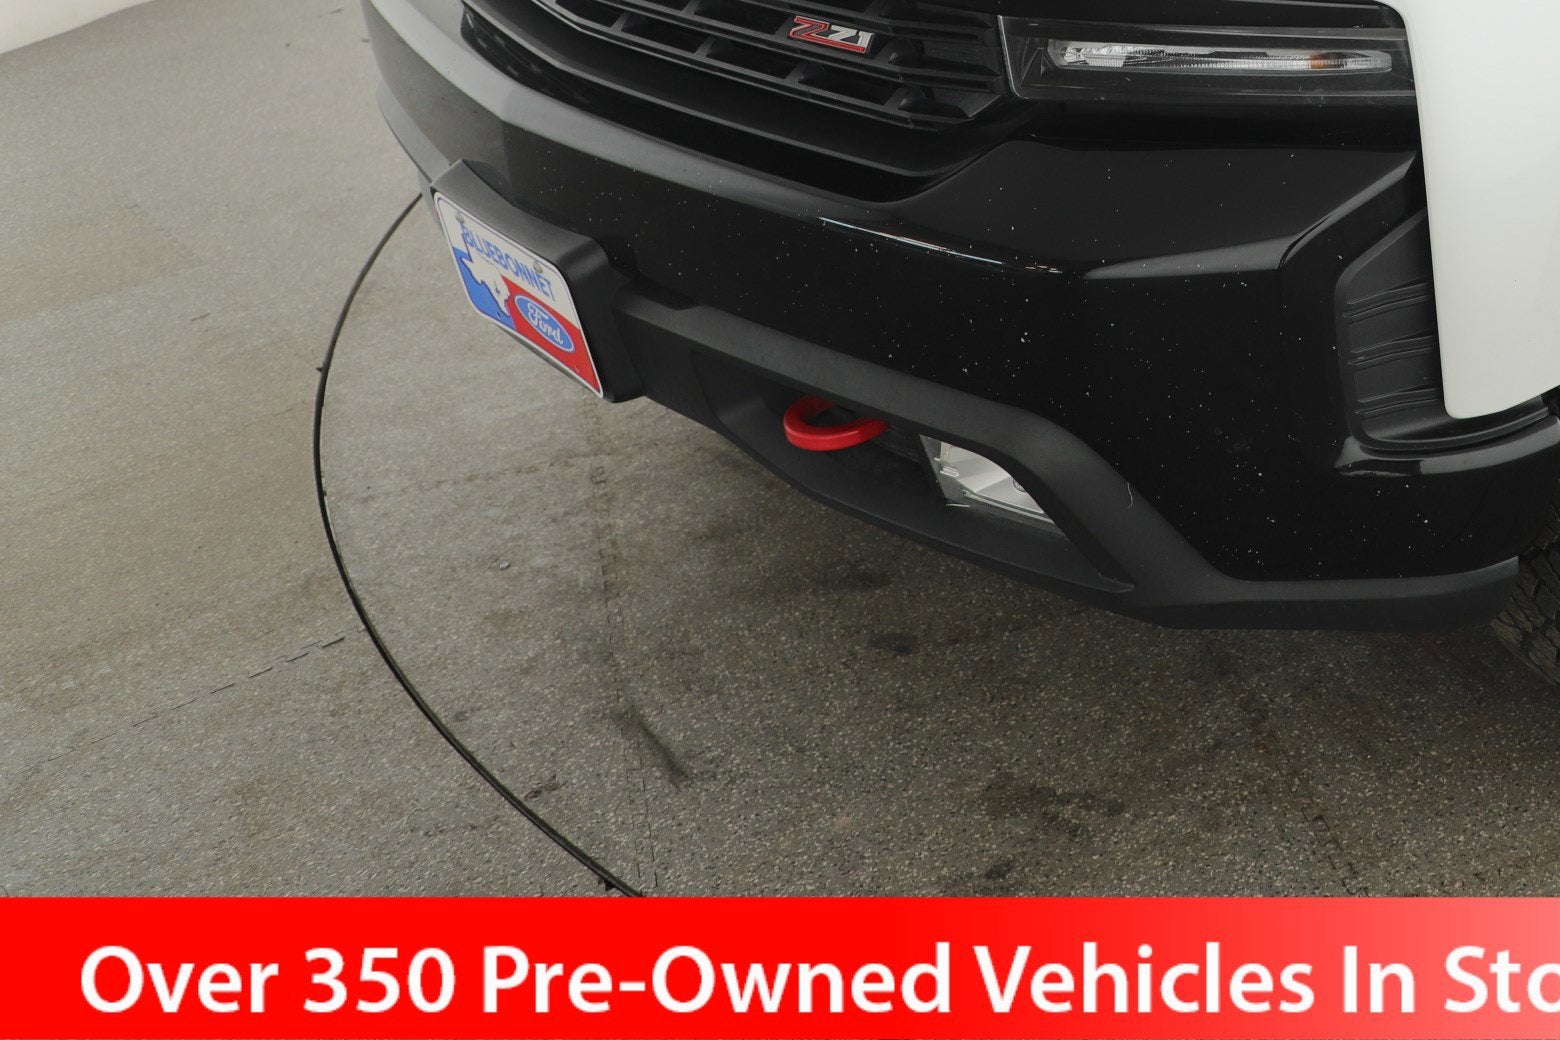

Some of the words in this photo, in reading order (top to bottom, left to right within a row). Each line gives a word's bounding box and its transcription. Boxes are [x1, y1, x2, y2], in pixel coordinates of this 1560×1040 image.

[789, 16, 874, 54] Z71
[461, 223, 556, 301] BLUEBONNET
[527, 303, 564, 345] Ford
